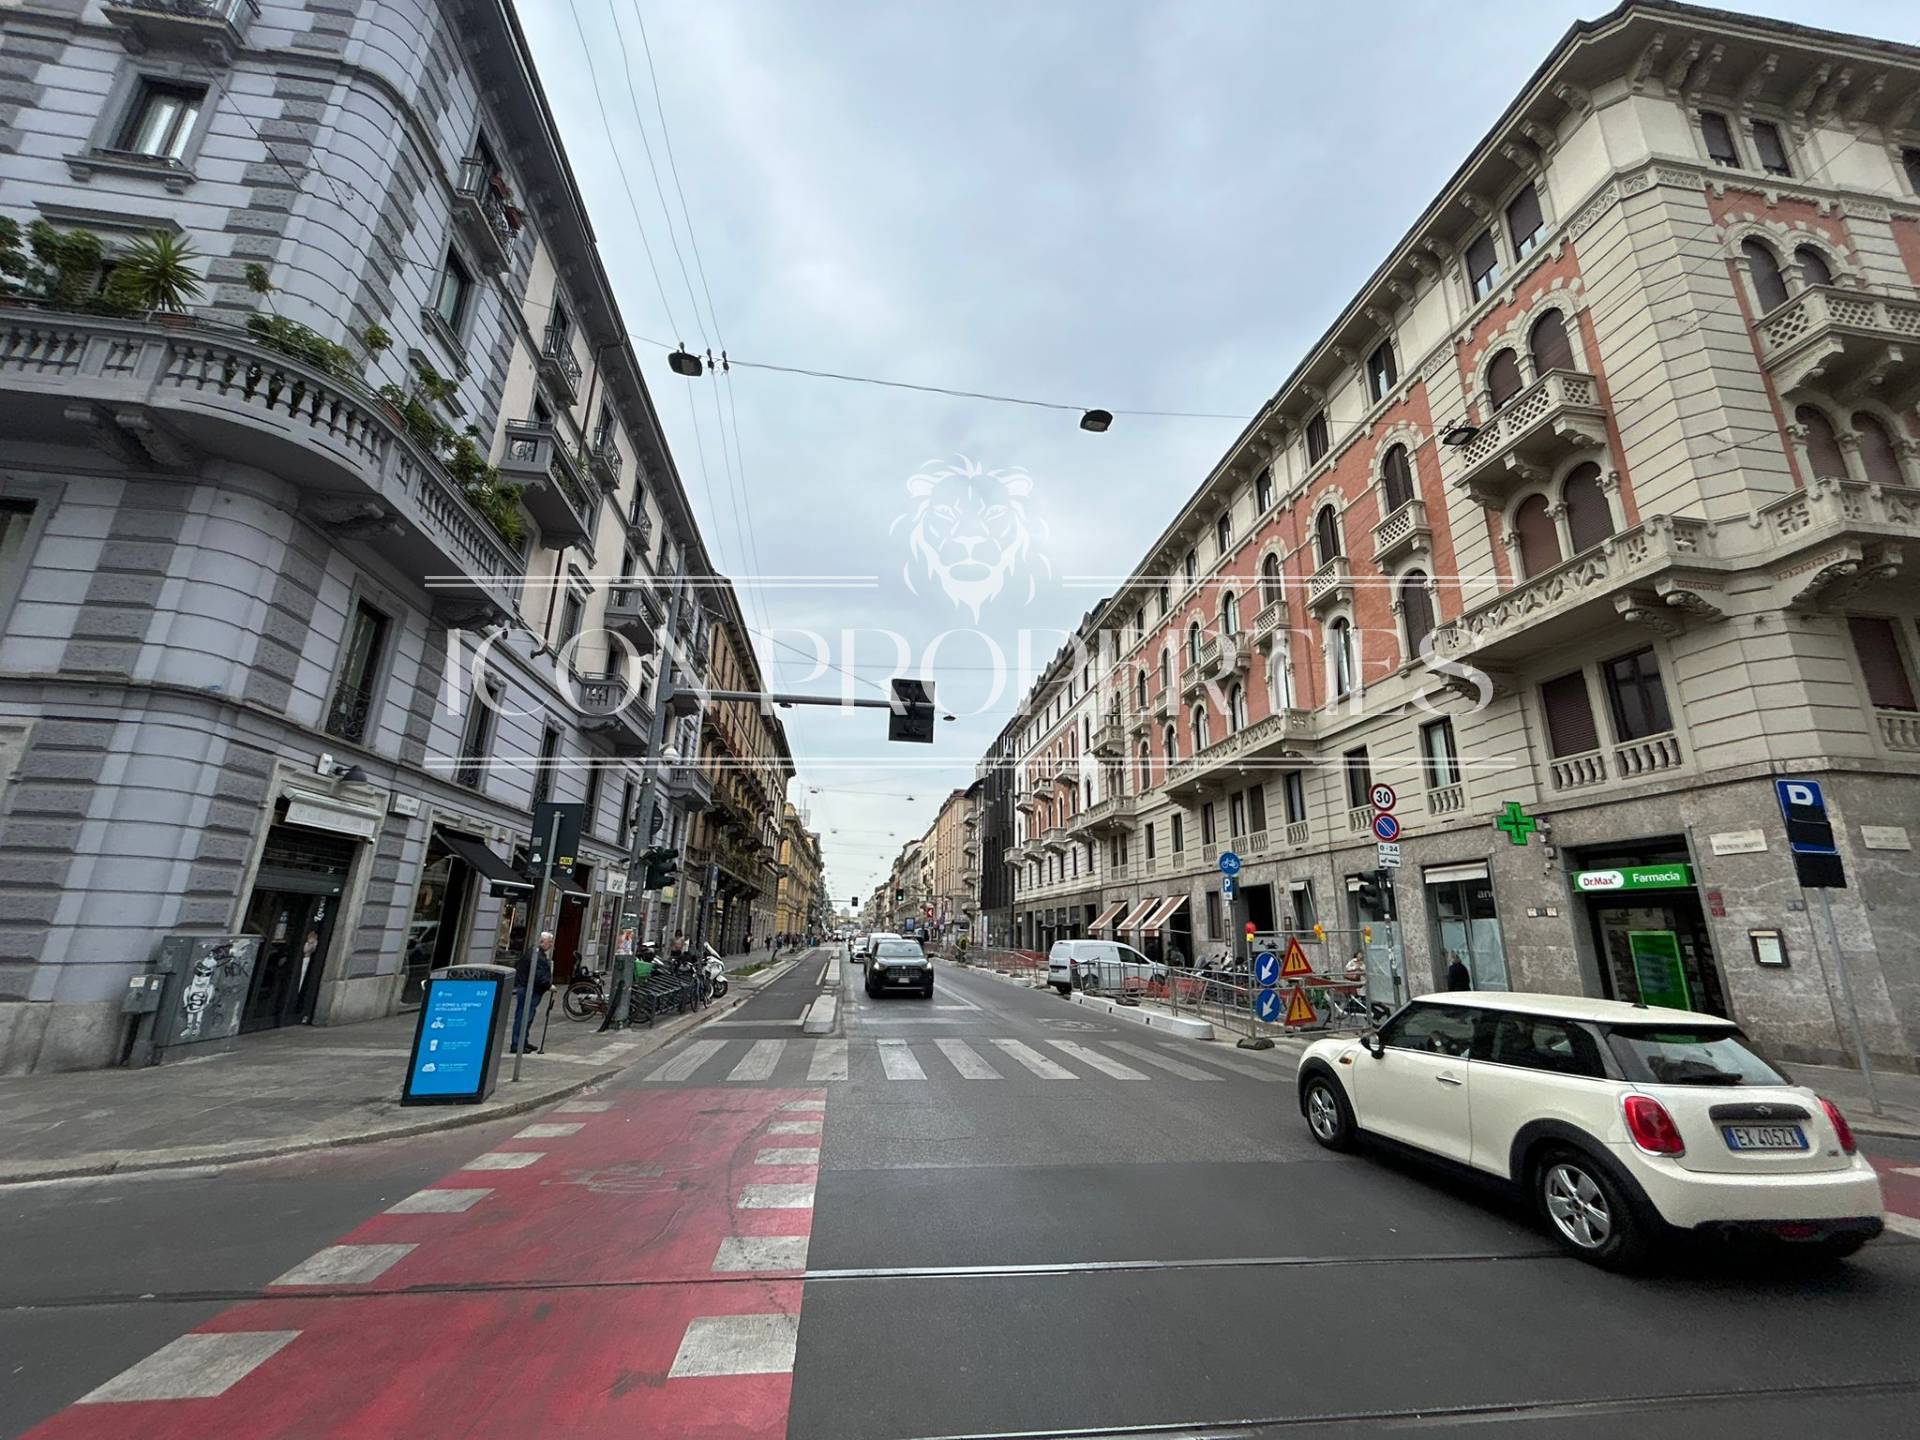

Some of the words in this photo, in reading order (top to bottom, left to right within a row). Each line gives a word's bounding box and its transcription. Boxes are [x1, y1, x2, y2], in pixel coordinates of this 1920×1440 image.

[1376, 790, 1390, 803] 30
[1225, 878, 1231, 891] P
[1583, 876, 1614, 886] Dr.Max
[1632, 871, 1680, 883] Farmacia
